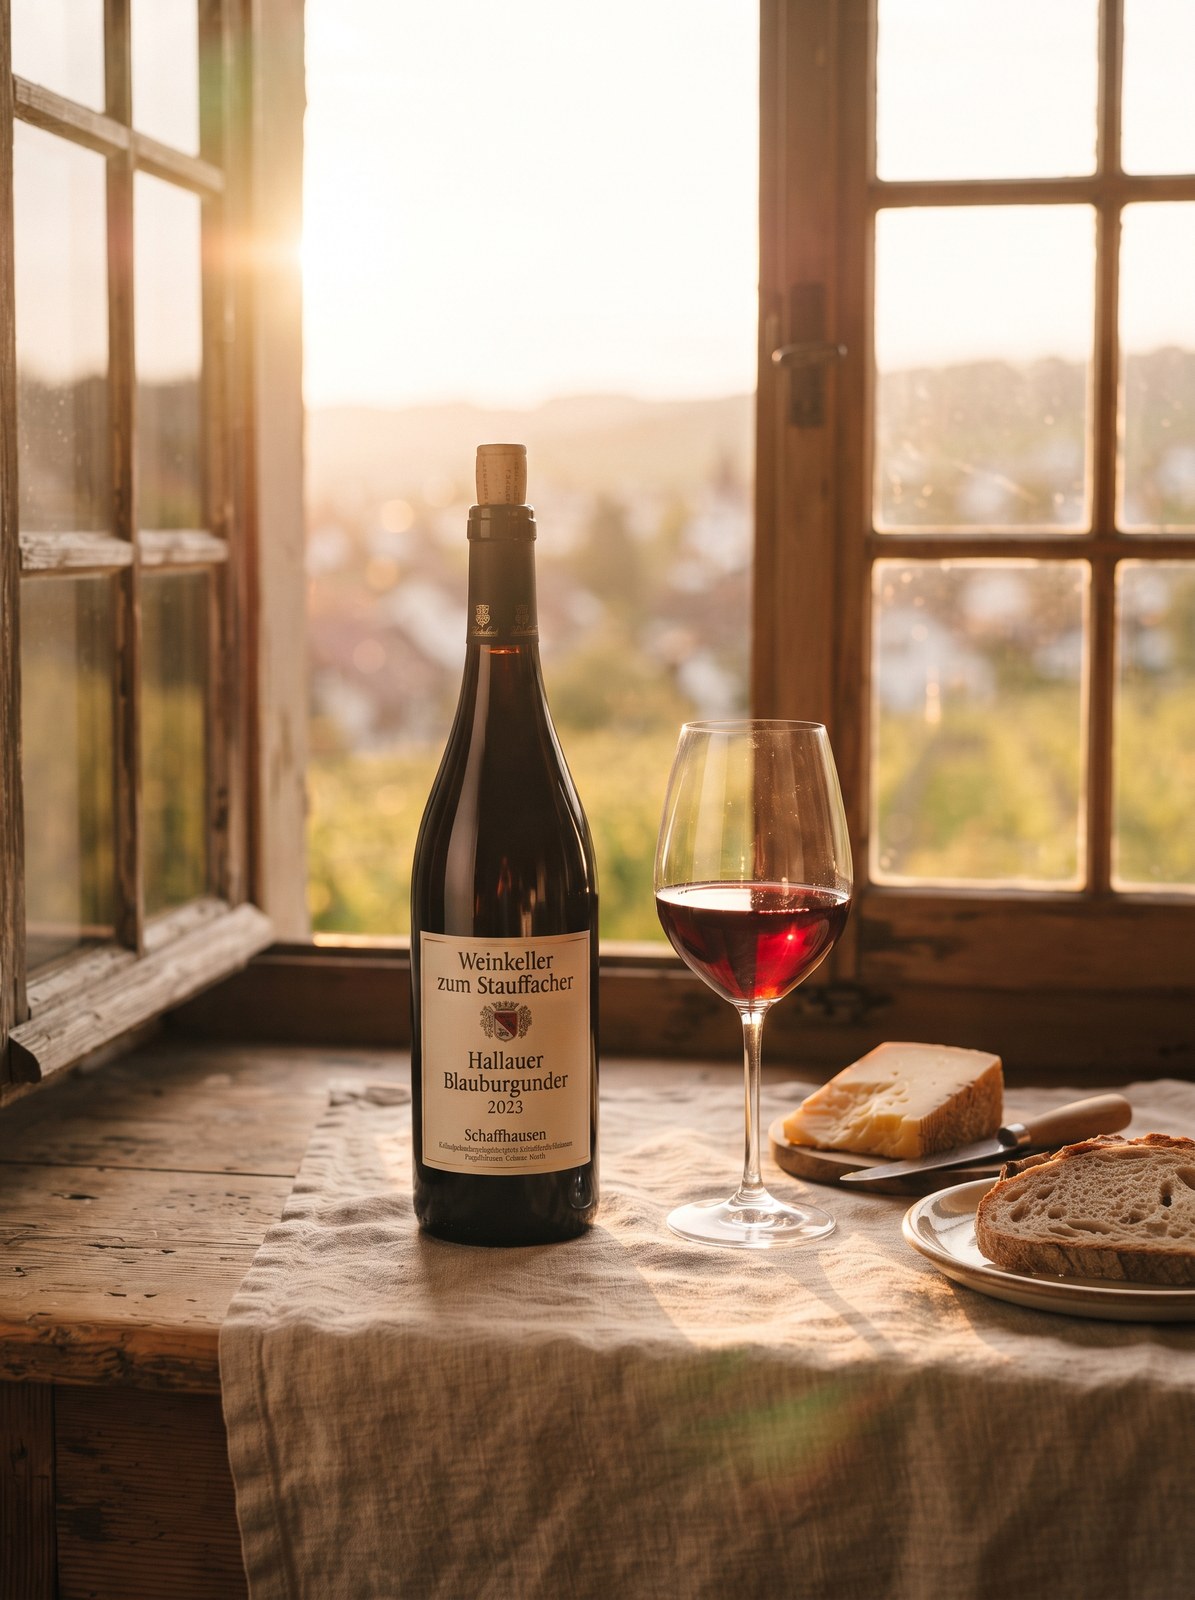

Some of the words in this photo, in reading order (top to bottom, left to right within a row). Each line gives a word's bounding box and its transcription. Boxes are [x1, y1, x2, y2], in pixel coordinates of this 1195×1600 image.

[458, 951, 553, 970] Weinkeller
[437, 976, 471, 993] zum
[477, 974, 574, 995] Stauffacher
[468, 1051, 544, 1070] Hallauer
[444, 1072, 568, 1098] Blauburgunder
[487, 1100, 523, 1114] 2023
[464, 1129, 547, 1143] Schaffhausen
